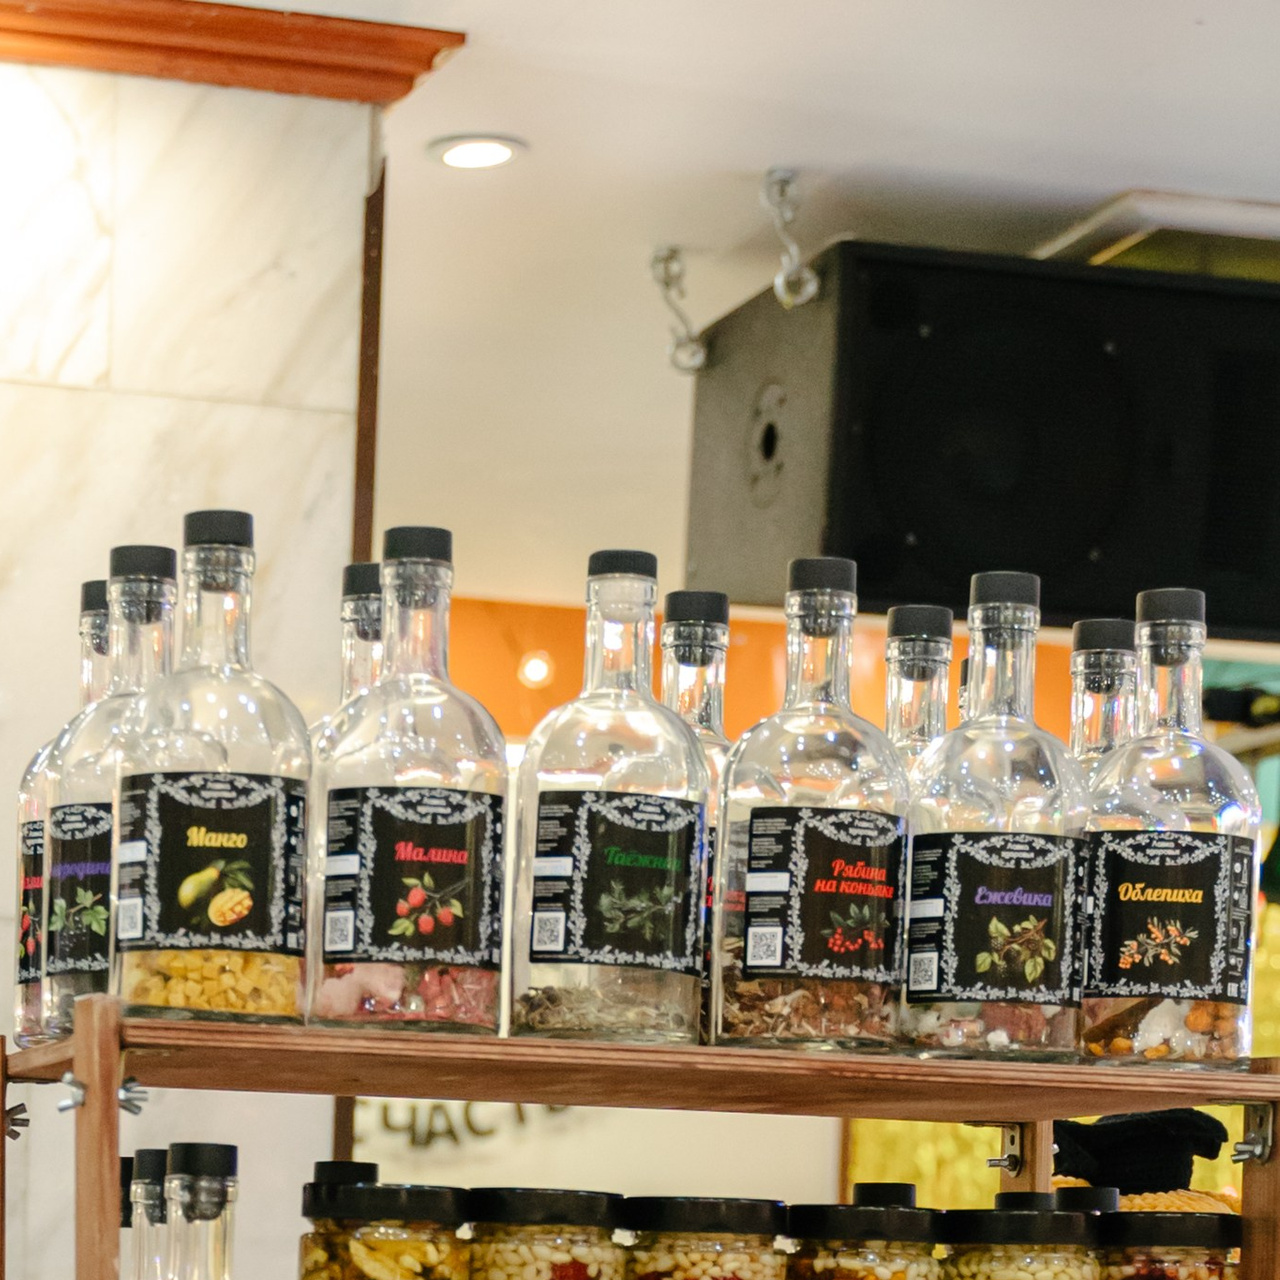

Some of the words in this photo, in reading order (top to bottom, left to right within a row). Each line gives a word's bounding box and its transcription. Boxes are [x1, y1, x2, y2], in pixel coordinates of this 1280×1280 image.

[186, 825, 248, 848] Манго
[394, 841, 469, 865] Малина
[831, 858, 888, 881] Рябина
[814, 879, 837, 893] на
[975, 886, 1054, 907] Ежевика
[1118, 882, 1203, 904] Облепиха
